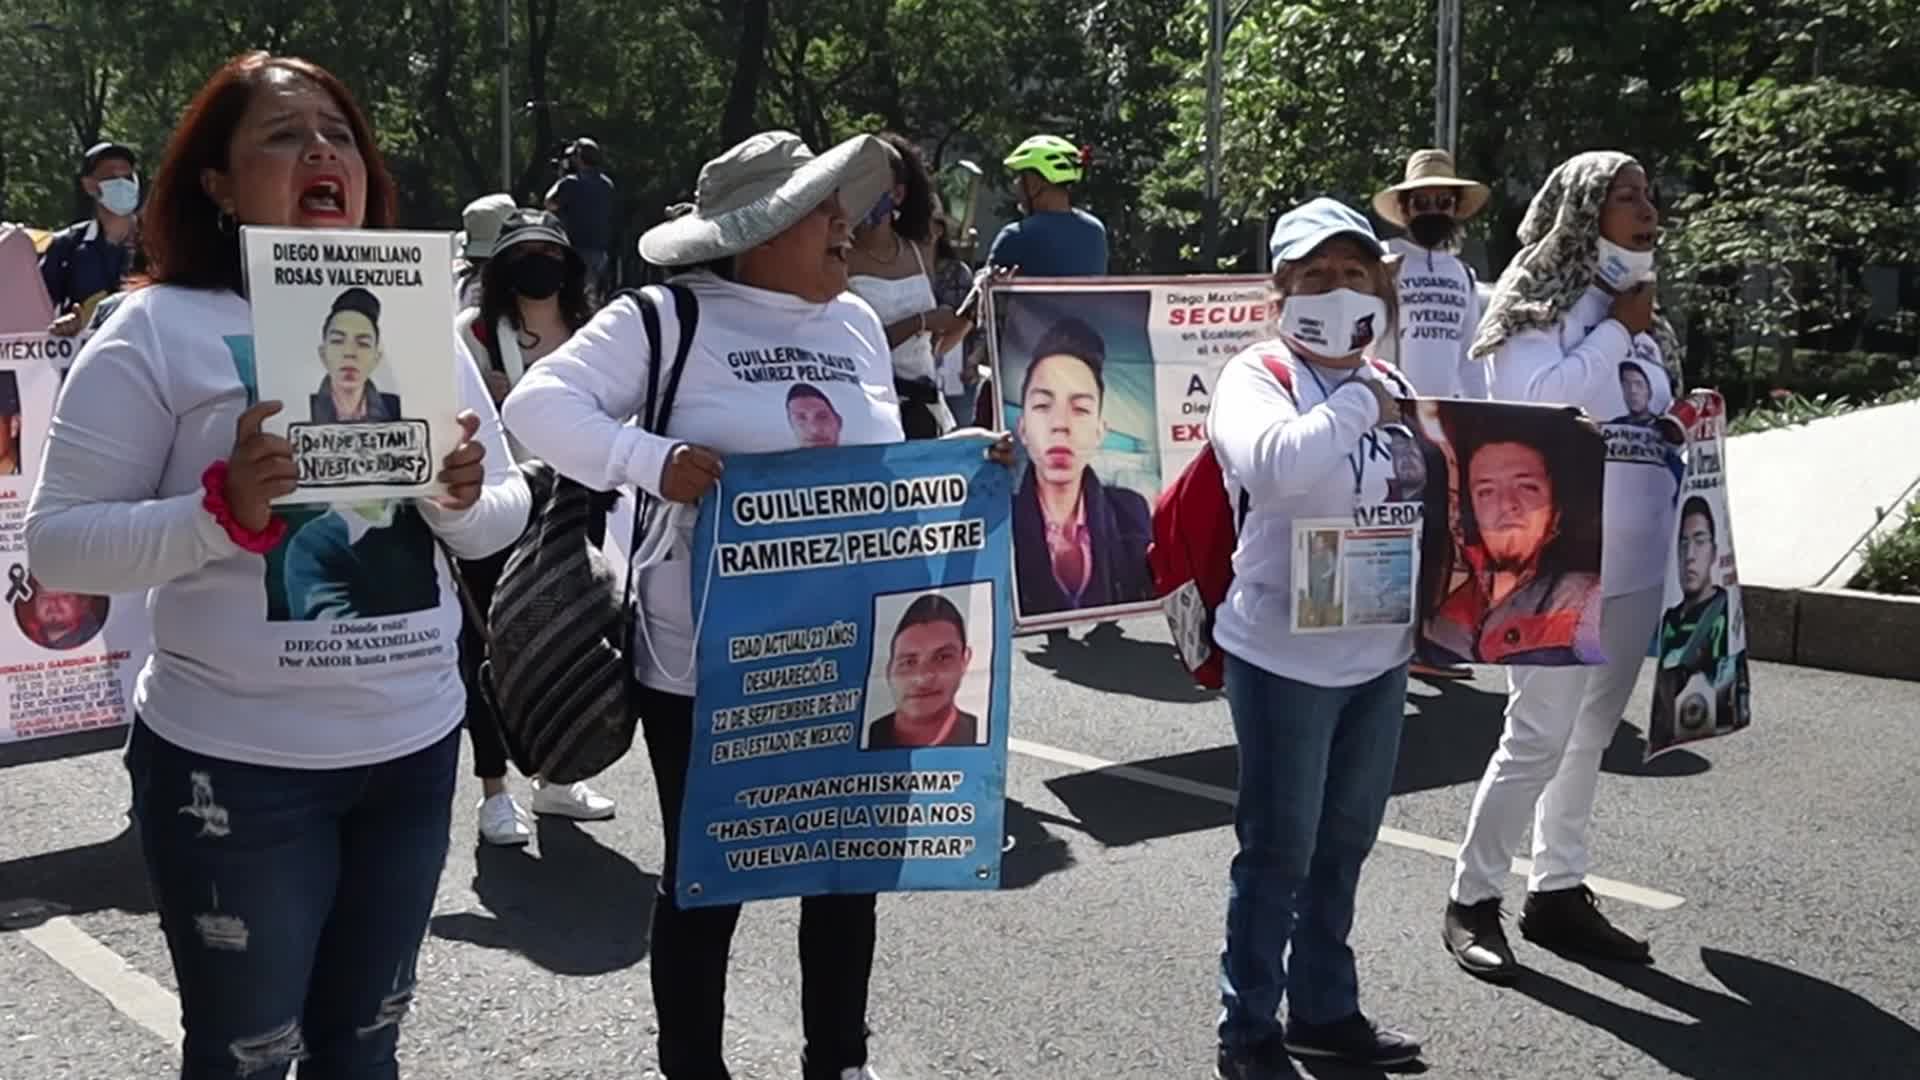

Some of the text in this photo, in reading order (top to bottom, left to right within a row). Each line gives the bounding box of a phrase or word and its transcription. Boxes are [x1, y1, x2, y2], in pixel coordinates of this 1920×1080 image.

[273, 243, 422, 263] DIEGO MAXIMILIANO
[274, 267, 423, 287] ROSAS VALENZUELA
[1167, 293, 1204, 305] Diego
[1171, 424, 1206, 442] EX
[735, 477, 964, 523] GUILLERMO DAVID
[721, 521, 982, 574] RAMIREZ PELCASTRE
[284, 627, 442, 653] DIEGO MAXIMILIANO
[731, 621, 856, 660] EDAD ACTUAL 23 AÑOS
[305, 655, 352, 668] AMOR
[745, 658, 836, 692] DESAPARECIÓ EL
[714, 709, 728, 731] 22
[730, 707, 746, 729] DE
[747, 700, 817, 724] SEPTIEMBRE
[817, 697, 833, 714] DE
[714, 724, 852, 761] EN EL ESTADO DE MEXICO
[793, 809, 836, 832] QUE
[841, 806, 868, 827] LA
[875, 804, 923, 825] VIDA
[929, 804, 974, 824] NOS
[728, 843, 807, 870] VUELVA
[813, 843, 829, 859] A
